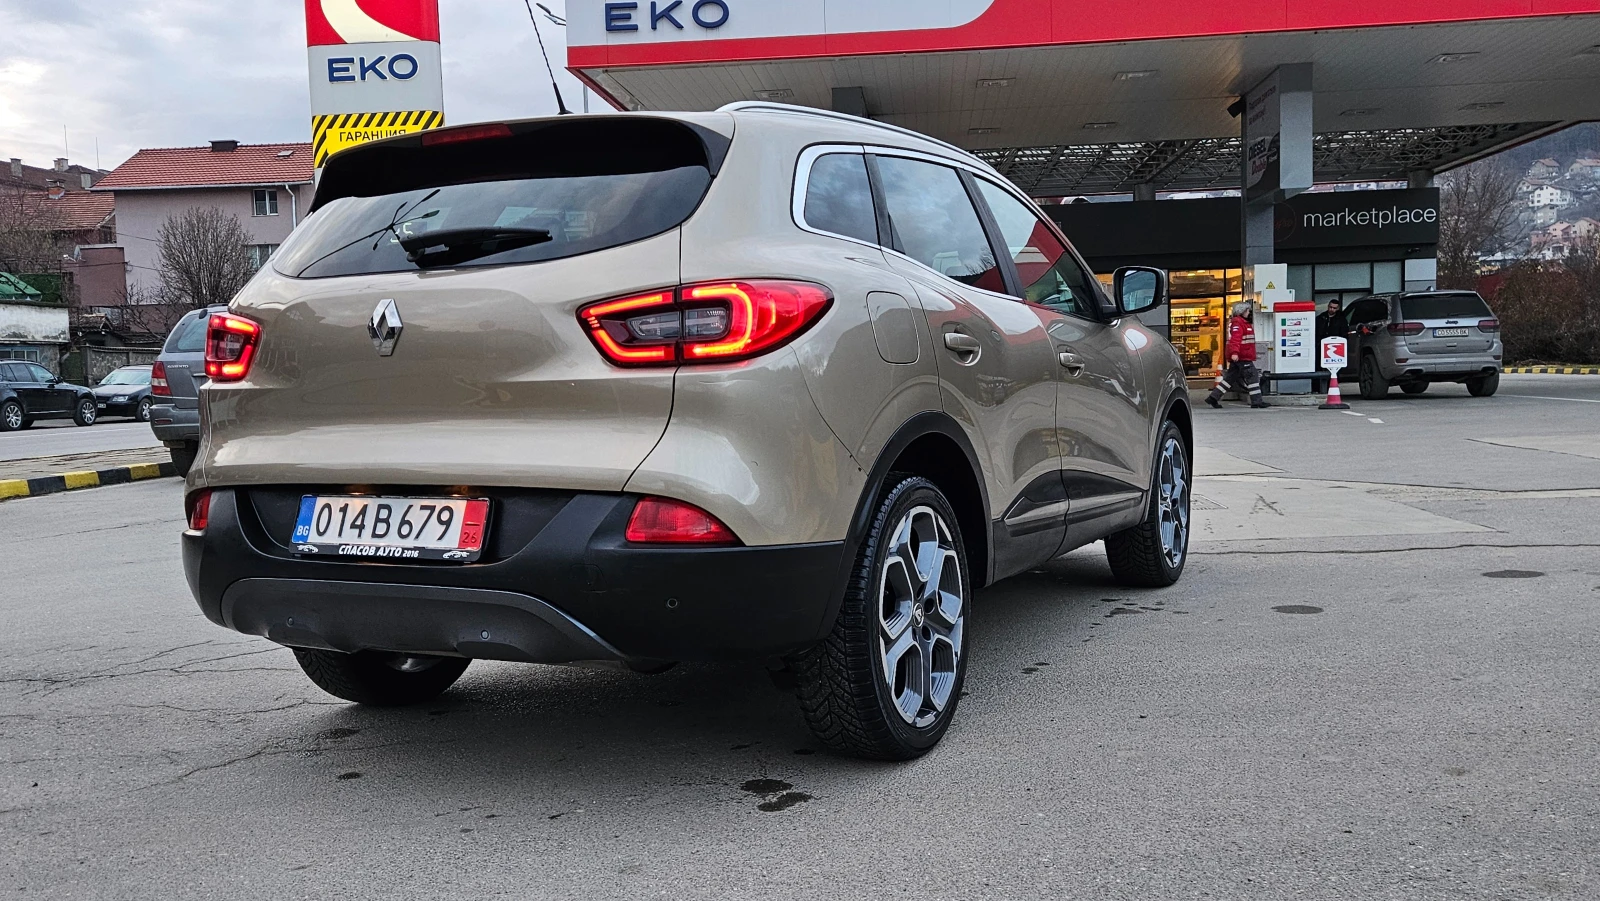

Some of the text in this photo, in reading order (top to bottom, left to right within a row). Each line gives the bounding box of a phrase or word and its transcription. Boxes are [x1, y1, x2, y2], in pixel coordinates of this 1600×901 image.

[605, 0, 730, 31] EKO
[328, 53, 419, 82] EKO
[1303, 206, 1437, 229] marketplace
[296, 525, 309, 536] BG
[462, 532, 477, 544] 26
[338, 544, 419, 558] СПАСОВ АУТО 2016
